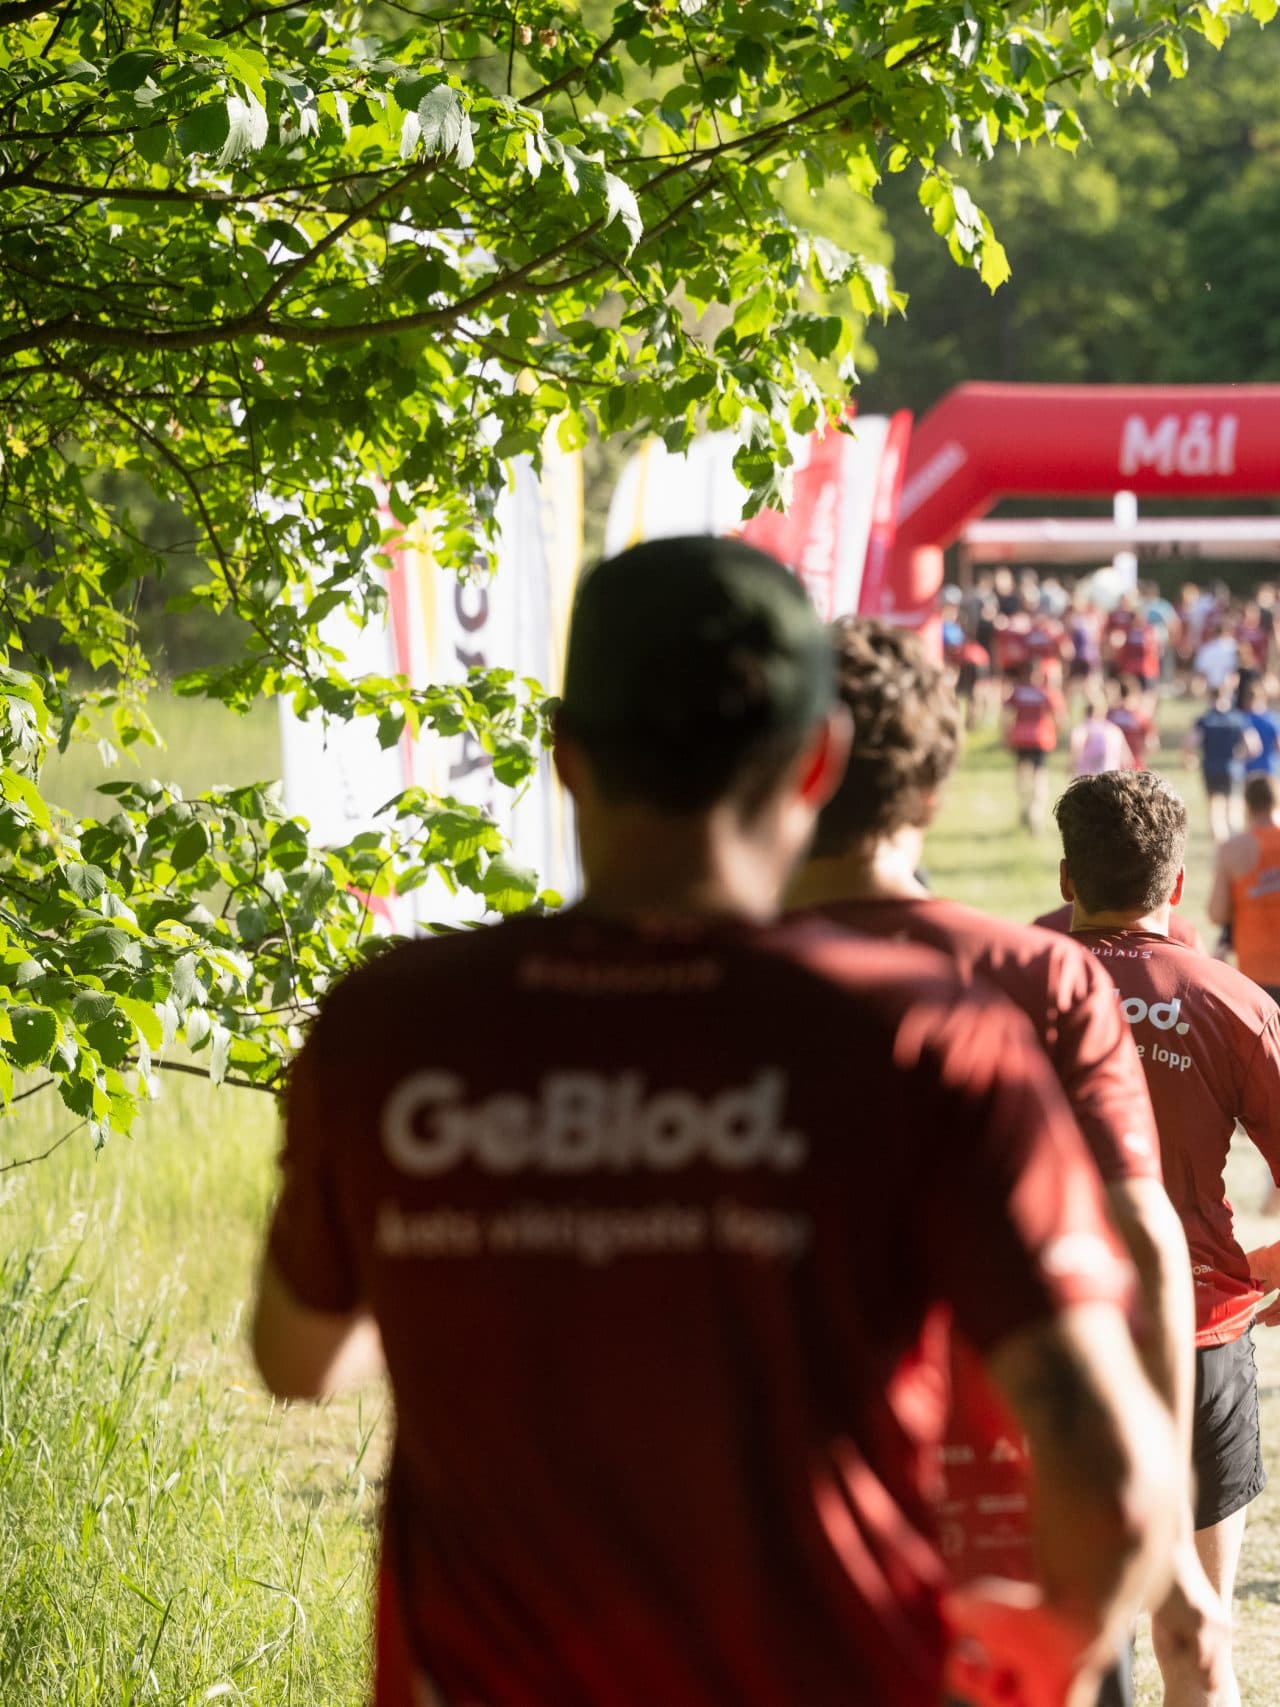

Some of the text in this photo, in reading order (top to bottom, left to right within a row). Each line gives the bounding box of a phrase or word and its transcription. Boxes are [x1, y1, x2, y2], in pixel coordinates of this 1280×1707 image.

[1119, 411, 1238, 476] Mål
[1152, 1042, 1192, 1073] lopp
[384, 1069, 806, 1175] GeBlod.
